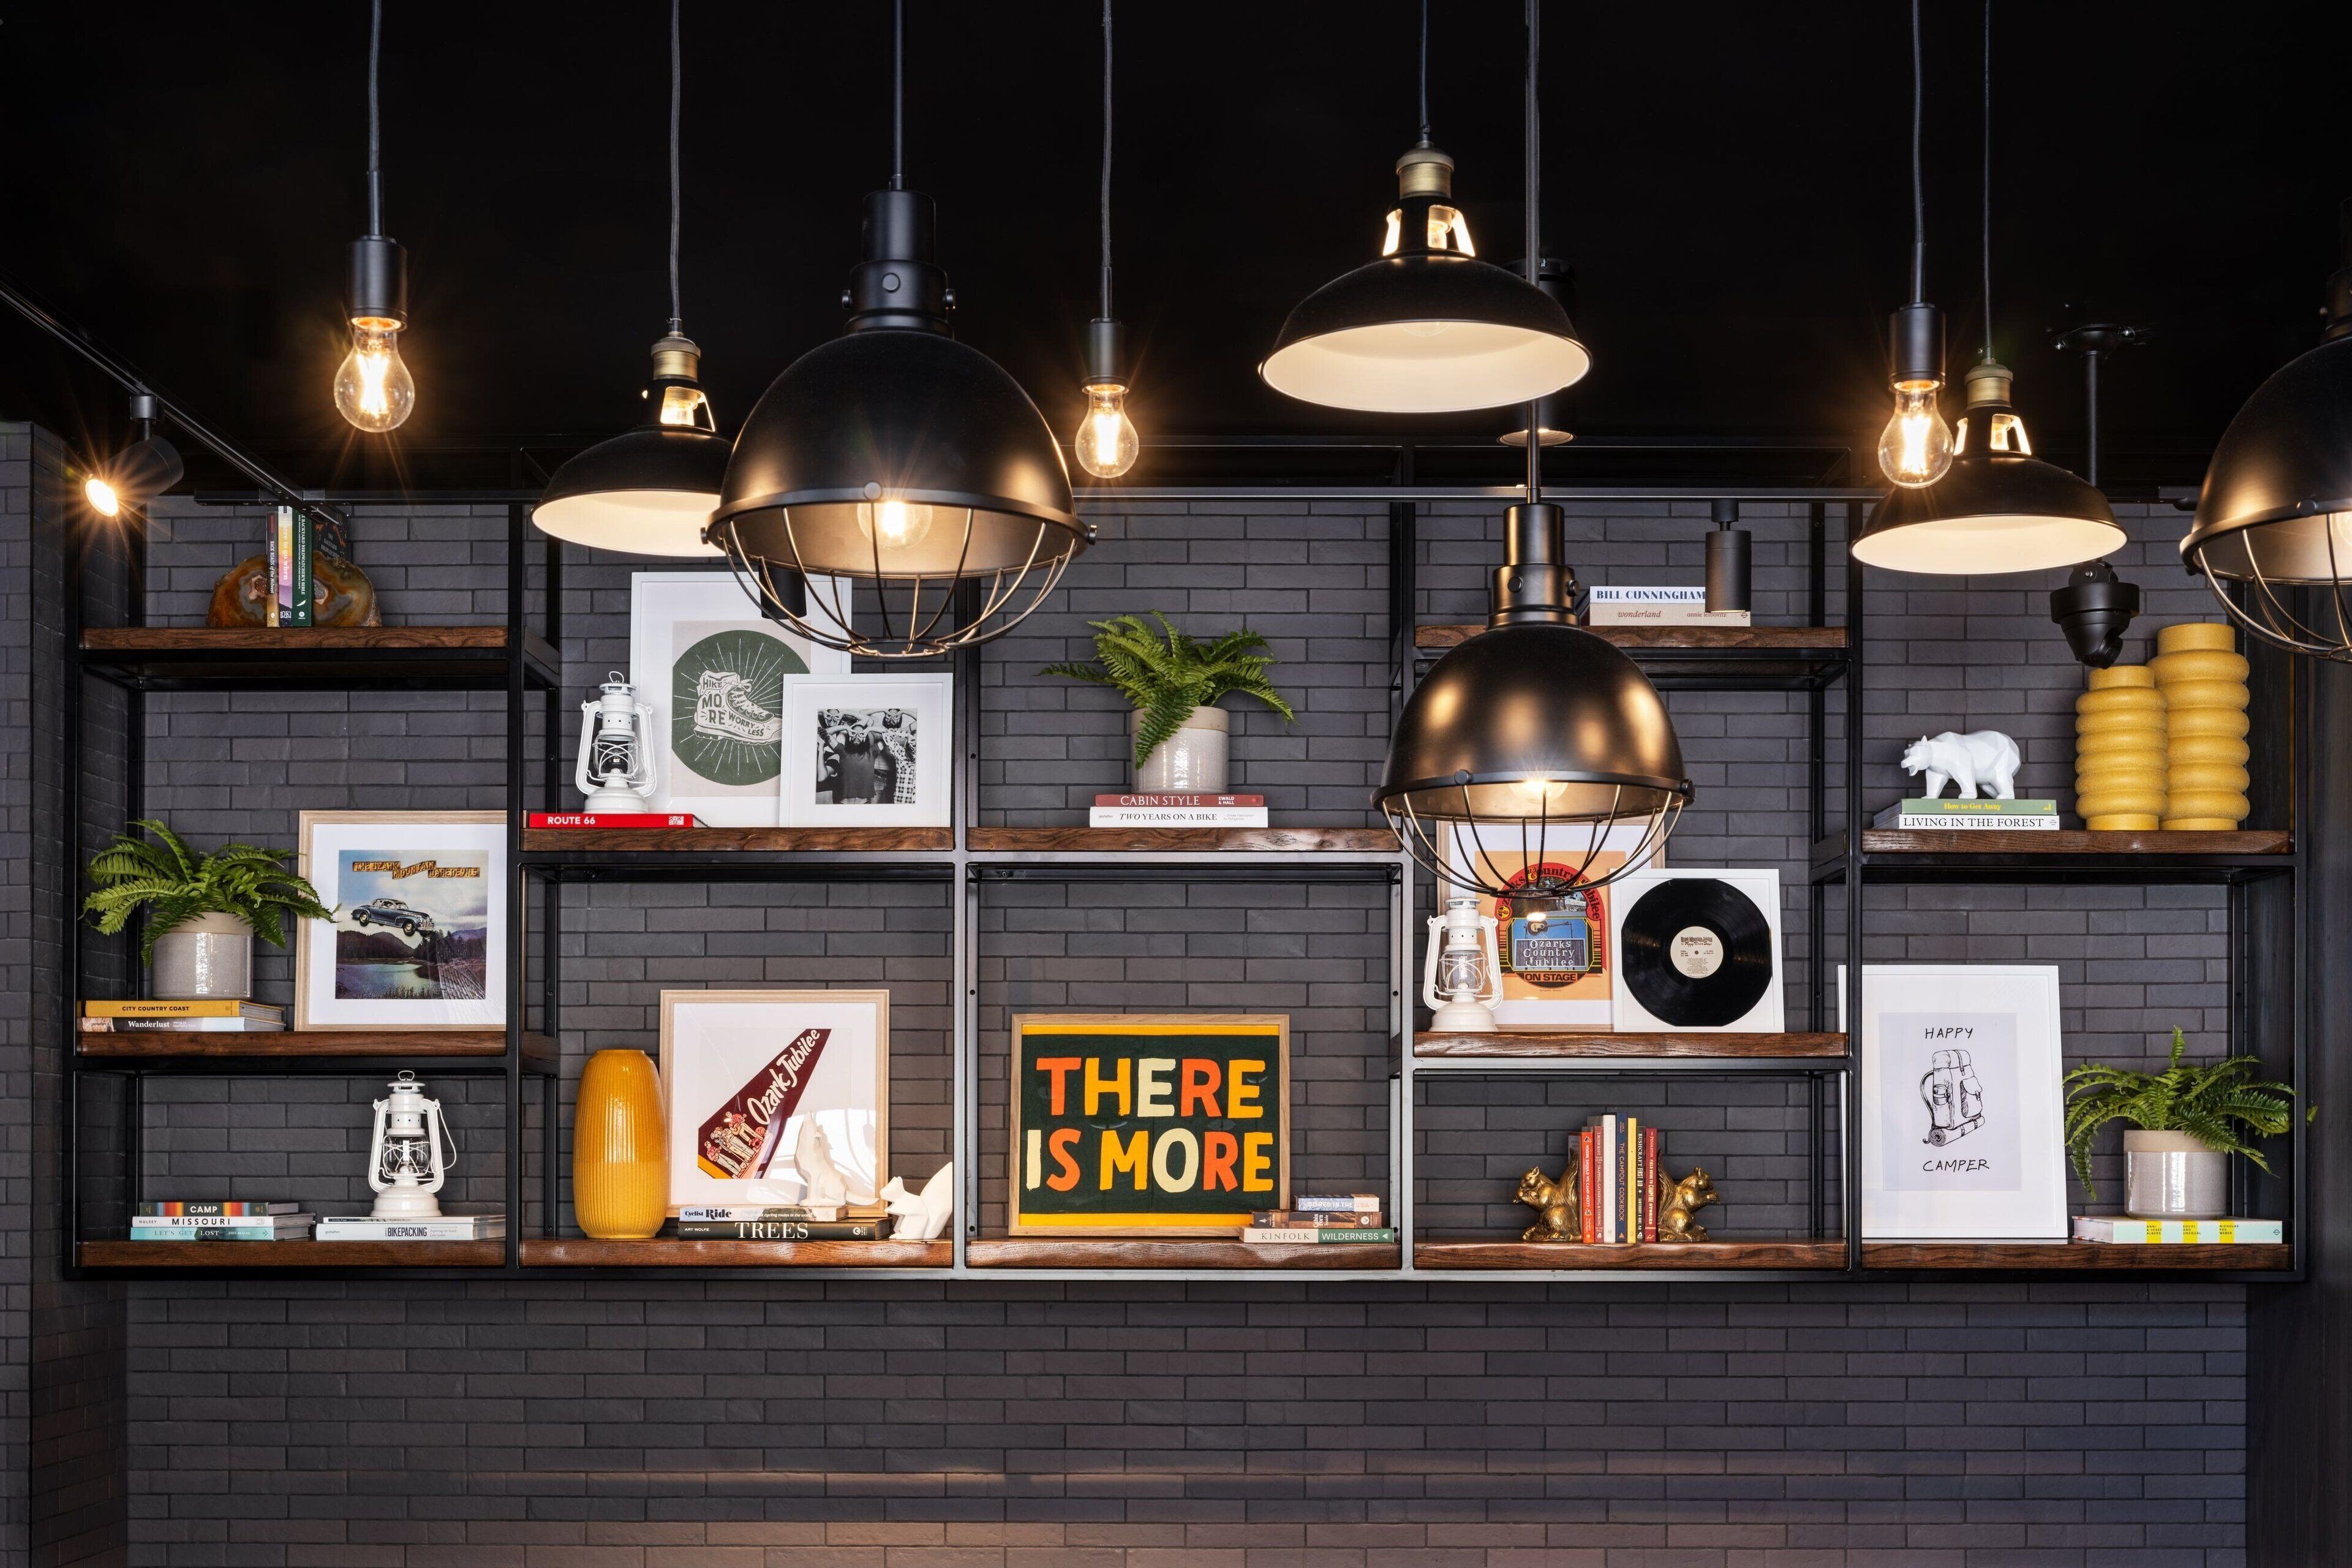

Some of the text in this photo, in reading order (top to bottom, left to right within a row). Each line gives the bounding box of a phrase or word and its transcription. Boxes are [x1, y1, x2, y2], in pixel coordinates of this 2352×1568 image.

[1597, 590, 1706, 599] BILL CUNNINGHAM
[703, 677, 723, 690] HIKE
[702, 693, 722, 709] MO
[709, 709, 725, 725] RE
[728, 711, 756, 728] WORRY
[1120, 796, 1200, 805] CABIN STYLE
[548, 816, 596, 824] ROUTE 66
[1904, 818, 2044, 827] LIVING IN THE FOREST
[355, 861, 399, 871] THE OZARK
[393, 861, 435, 879] MOUNTAIN
[429, 868, 478, 877] DAREDEVILS
[1530, 940, 1571, 949] Ozarks
[1523, 949, 1575, 958] Country
[1526, 957, 1575, 967] Jubilee
[1924, 1027, 1973, 1039] HAPPY
[747, 1030, 820, 1125] Ozark Jubilee
[1036, 1057, 1266, 1118] THERE
[1026, 1128, 1274, 1193] IS MORE
[1923, 1159, 1990, 1172] CAMPER
[706, 1209, 732, 1220] Ride
[387, 1227, 428, 1237] BIKEPACKING
[735, 1222, 809, 1239] TREES
